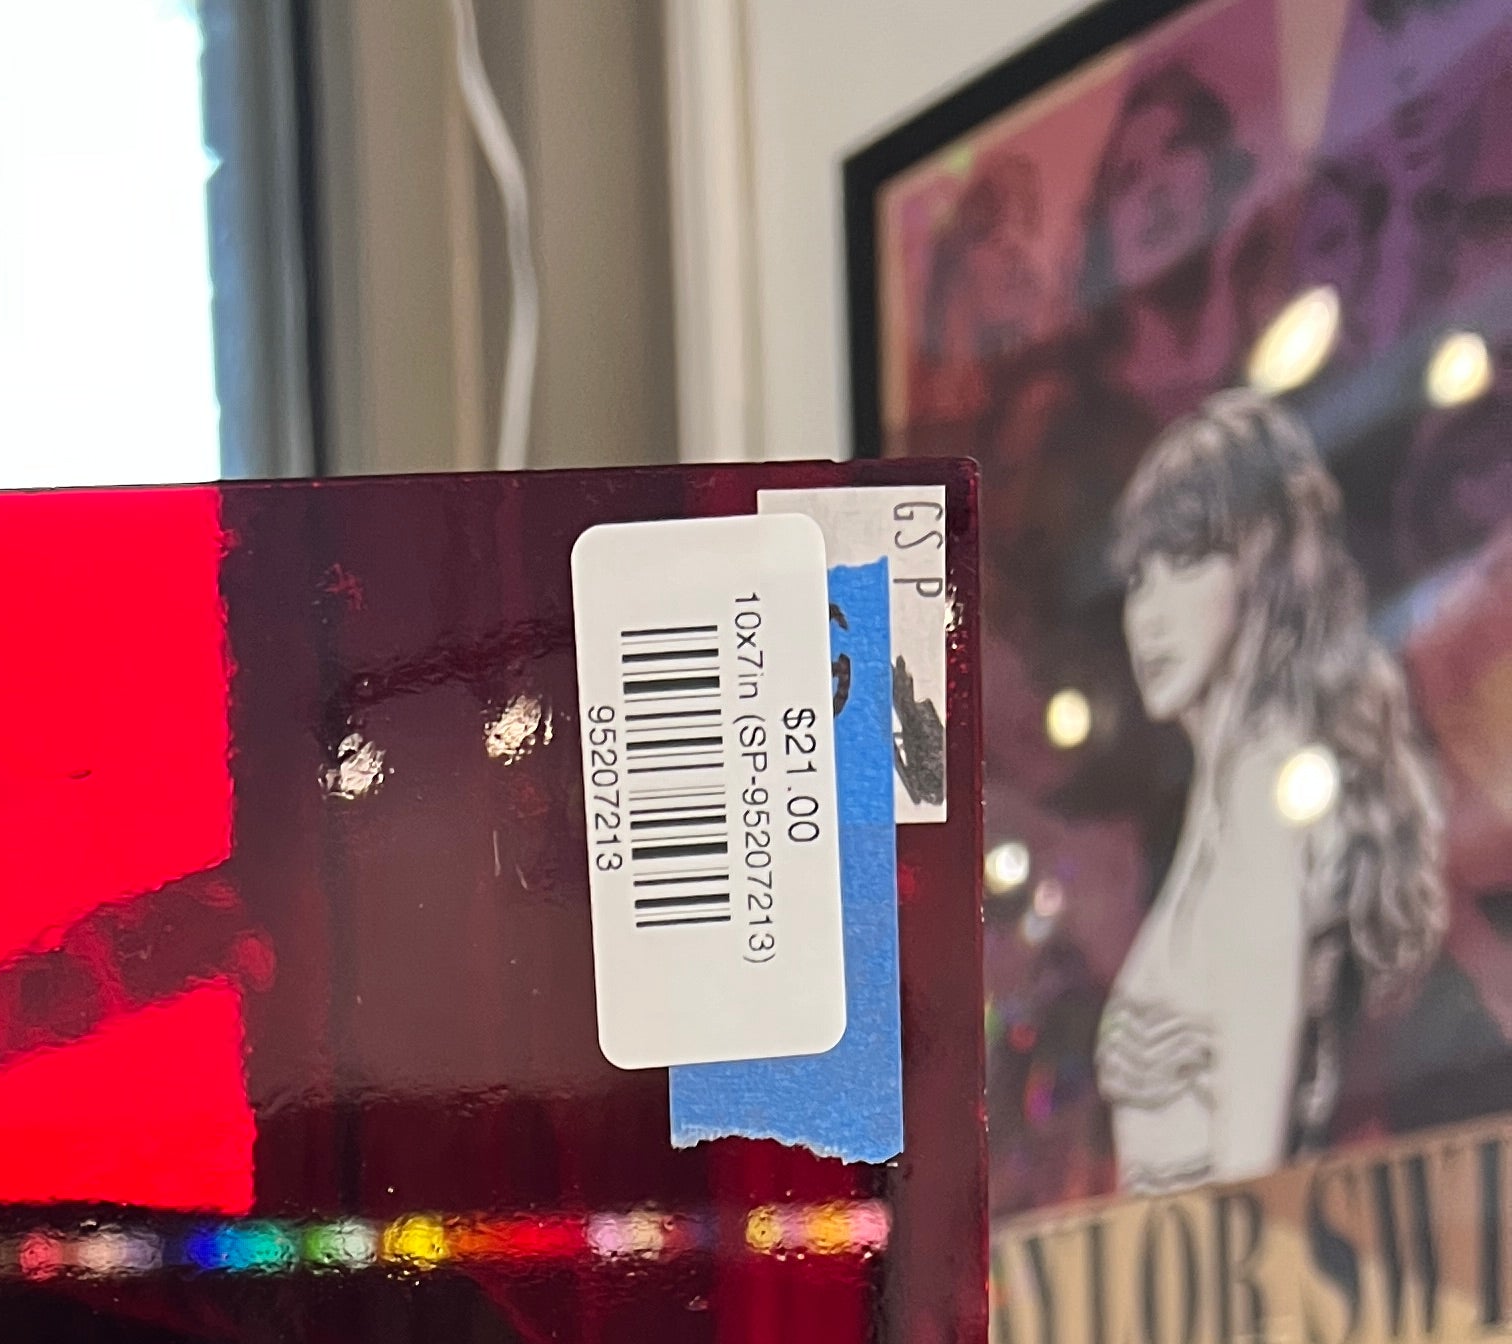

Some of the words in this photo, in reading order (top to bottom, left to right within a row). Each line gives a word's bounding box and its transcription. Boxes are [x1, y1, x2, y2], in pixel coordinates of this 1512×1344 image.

[734, 591, 765, 700] 10x7in
[588, 704, 624, 872] 95207213
[733, 714, 776, 964] (SP-95207213)
[780, 707, 820, 843] $21.00
